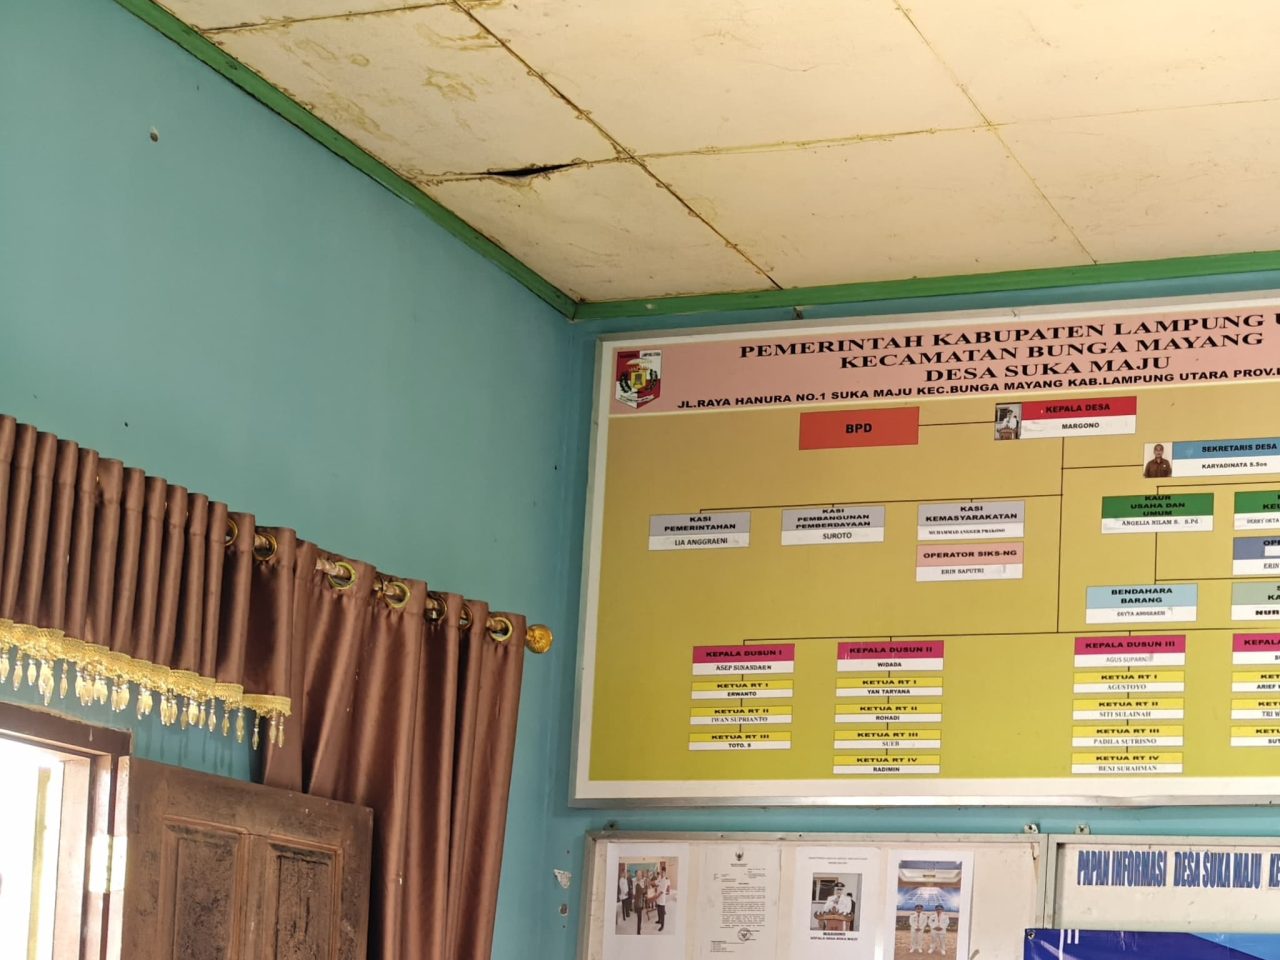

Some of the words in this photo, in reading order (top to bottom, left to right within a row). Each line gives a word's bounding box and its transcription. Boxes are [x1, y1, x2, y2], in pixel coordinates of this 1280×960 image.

[740, 335, 923, 358] PEMERINTAH
[933, 324, 1105, 346] KABUPATEN
[1114, 314, 1265, 336] LAMPUNG
[840, 347, 1019, 368] KECAMATAN
[1026, 341, 1128, 359] BUNGA
[1136, 332, 1264, 352] MAYANG
[925, 366, 998, 382] DESA
[1005, 359, 1083, 378] SUKA
[1090, 356, 1170, 373] MAJU
[678, 397, 731, 409] JL.RAYA
[735, 394, 792, 406] HANURA
[796, 392, 826, 403] NO.1
[831, 389, 869, 400] SUKA
[873, 387, 912, 399] MAJU
[917, 383, 999, 396] KEC.BUNGA
[1003, 379, 1063, 392] MAYANG
[1068, 373, 1174, 386] KAB.LAMPUNG
[1179, 370, 1229, 381] UTARA
[1046, 404, 1083, 414] KEPALA
[1087, 403, 1110, 412] DESA
[845, 422, 872, 434] BPD
[1062, 422, 1099, 430] MARGONO
[1202, 444, 1253, 453] SEKRETARIS
[1256, 442, 1277, 451] DESA
[1202, 461, 1247, 470] KARYADINATA
[798, 514, 869, 522] PEMBANGUNAN
[665, 524, 735, 532] PEMERINTAHAN
[687, 537, 728, 545] ANGGRAENI
[823, 532, 852, 540] SUROTO
[1077, 851, 1110, 886] PAPAN
[1111, 851, 1167, 886] INFORMASI
[1174, 852, 1200, 887] DESA
[1203, 852, 1231, 888] SUKA
[1232, 853, 1262, 888] MAJU
